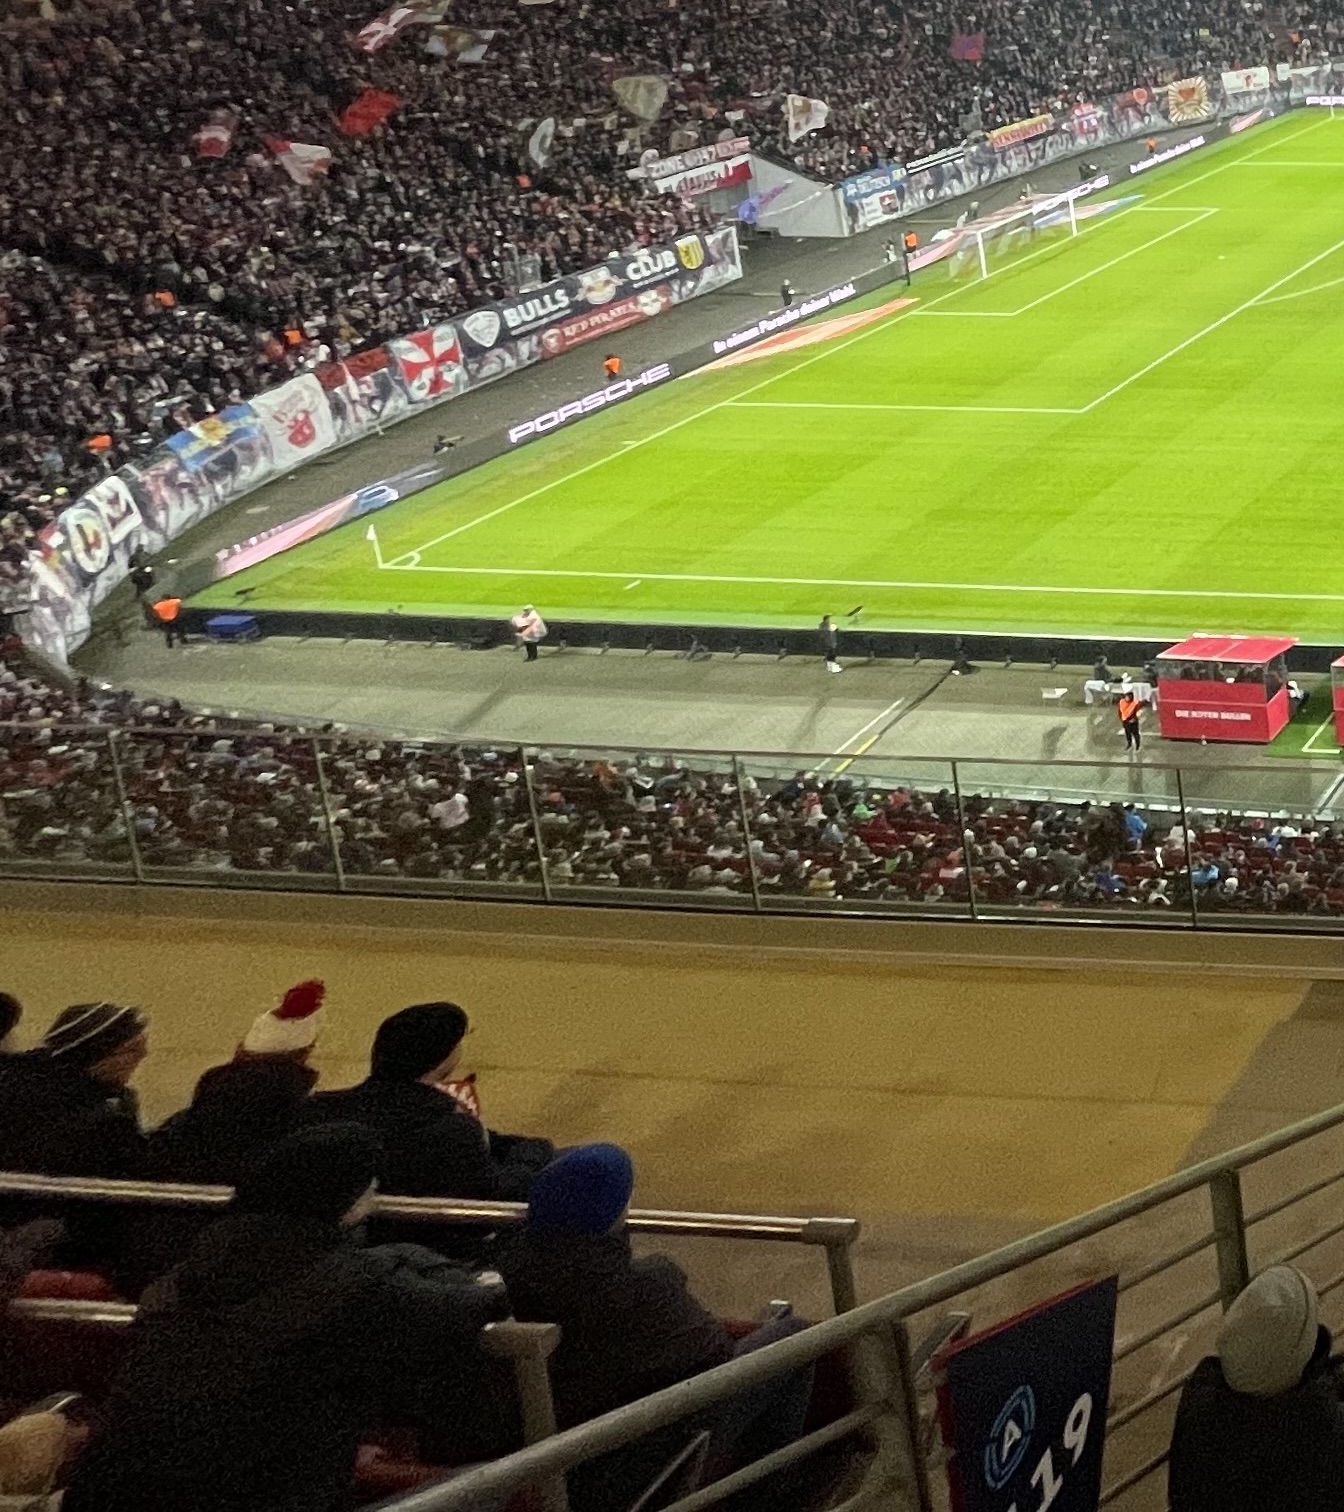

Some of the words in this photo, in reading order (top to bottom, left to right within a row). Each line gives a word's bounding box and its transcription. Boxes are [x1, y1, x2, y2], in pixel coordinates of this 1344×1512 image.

[502, 288, 570, 328] BULLS
[626, 250, 676, 281] CLUB
[508, 363, 672, 444] PORSCHE
